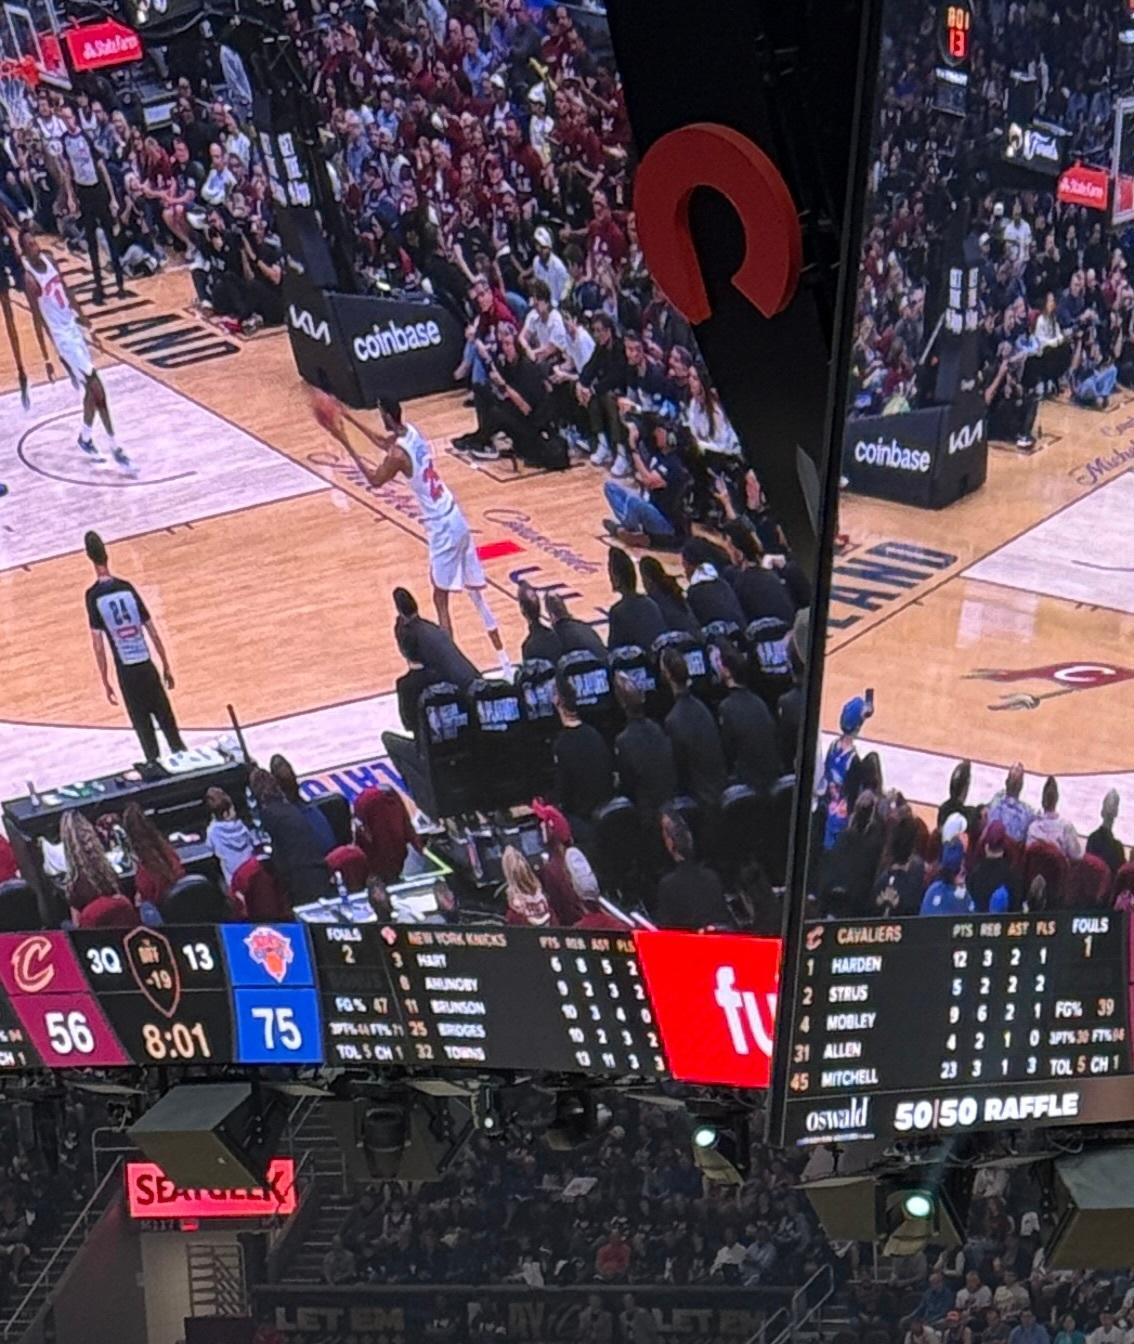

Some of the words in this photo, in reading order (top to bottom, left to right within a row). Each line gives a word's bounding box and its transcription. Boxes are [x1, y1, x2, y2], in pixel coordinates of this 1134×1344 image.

[353, 319, 442, 362] coinbase
[854, 437, 931, 472] coinbase
[327, 928, 362, 942] FOULS
[435, 932, 464, 947] YORK
[837, 925, 901, 944] CAVALIERS
[952, 923, 973, 938] PTS
[1007, 922, 1029, 936] AST
[1072, 918, 1109, 934] FOULS
[86, 947, 122, 974] 3Q
[182, 943, 214, 972] 13
[832, 956, 882, 974] HARDEN
[953, 951, 967, 968] 12
[982, 950, 992, 967] 3
[1011, 949, 1020, 966] 2
[1040, 948, 1047, 965] 1
[1084, 938, 1092, 958] 1
[146, 970, 172, 989] -19
[803, 988, 812, 1005] 2
[829, 985, 868, 1002] STRUS
[952, 978, 962, 995] 5
[980, 977, 989, 994] 2
[1007, 976, 1017, 993] 2
[1035, 975, 1045, 992] 2
[826, 1012, 876, 1031] MOBLEY
[950, 1007, 959, 1024] 9
[977, 1005, 987, 1022] 6
[1005, 1004, 1015, 1021] 2
[1034, 1002, 1041, 1019] 1
[1055, 1000, 1082, 1018] FG%
[1098, 998, 1114, 1016] 39
[45, 1012, 95, 1054] 56
[142, 1023, 212, 1060] 8:01
[252, 1007, 302, 1050] 75
[794, 1046, 810, 1063] 31
[823, 1042, 862, 1059] ALLEN
[975, 1032, 984, 1049] 2
[1030, 1029, 1040, 1047] 0
[790, 1072, 809, 1092] 45
[821, 1068, 878, 1088] MITCHELL
[941, 1061, 958, 1079] 23
[972, 1060, 981, 1078] 3
[1027, 1057, 1037, 1074] 3
[1050, 1058, 1072, 1076] TOL
[1091, 1056, 1109, 1073] CH
[806, 1097, 867, 1132] oswald
[984, 1093, 1079, 1122] RAFFLE
